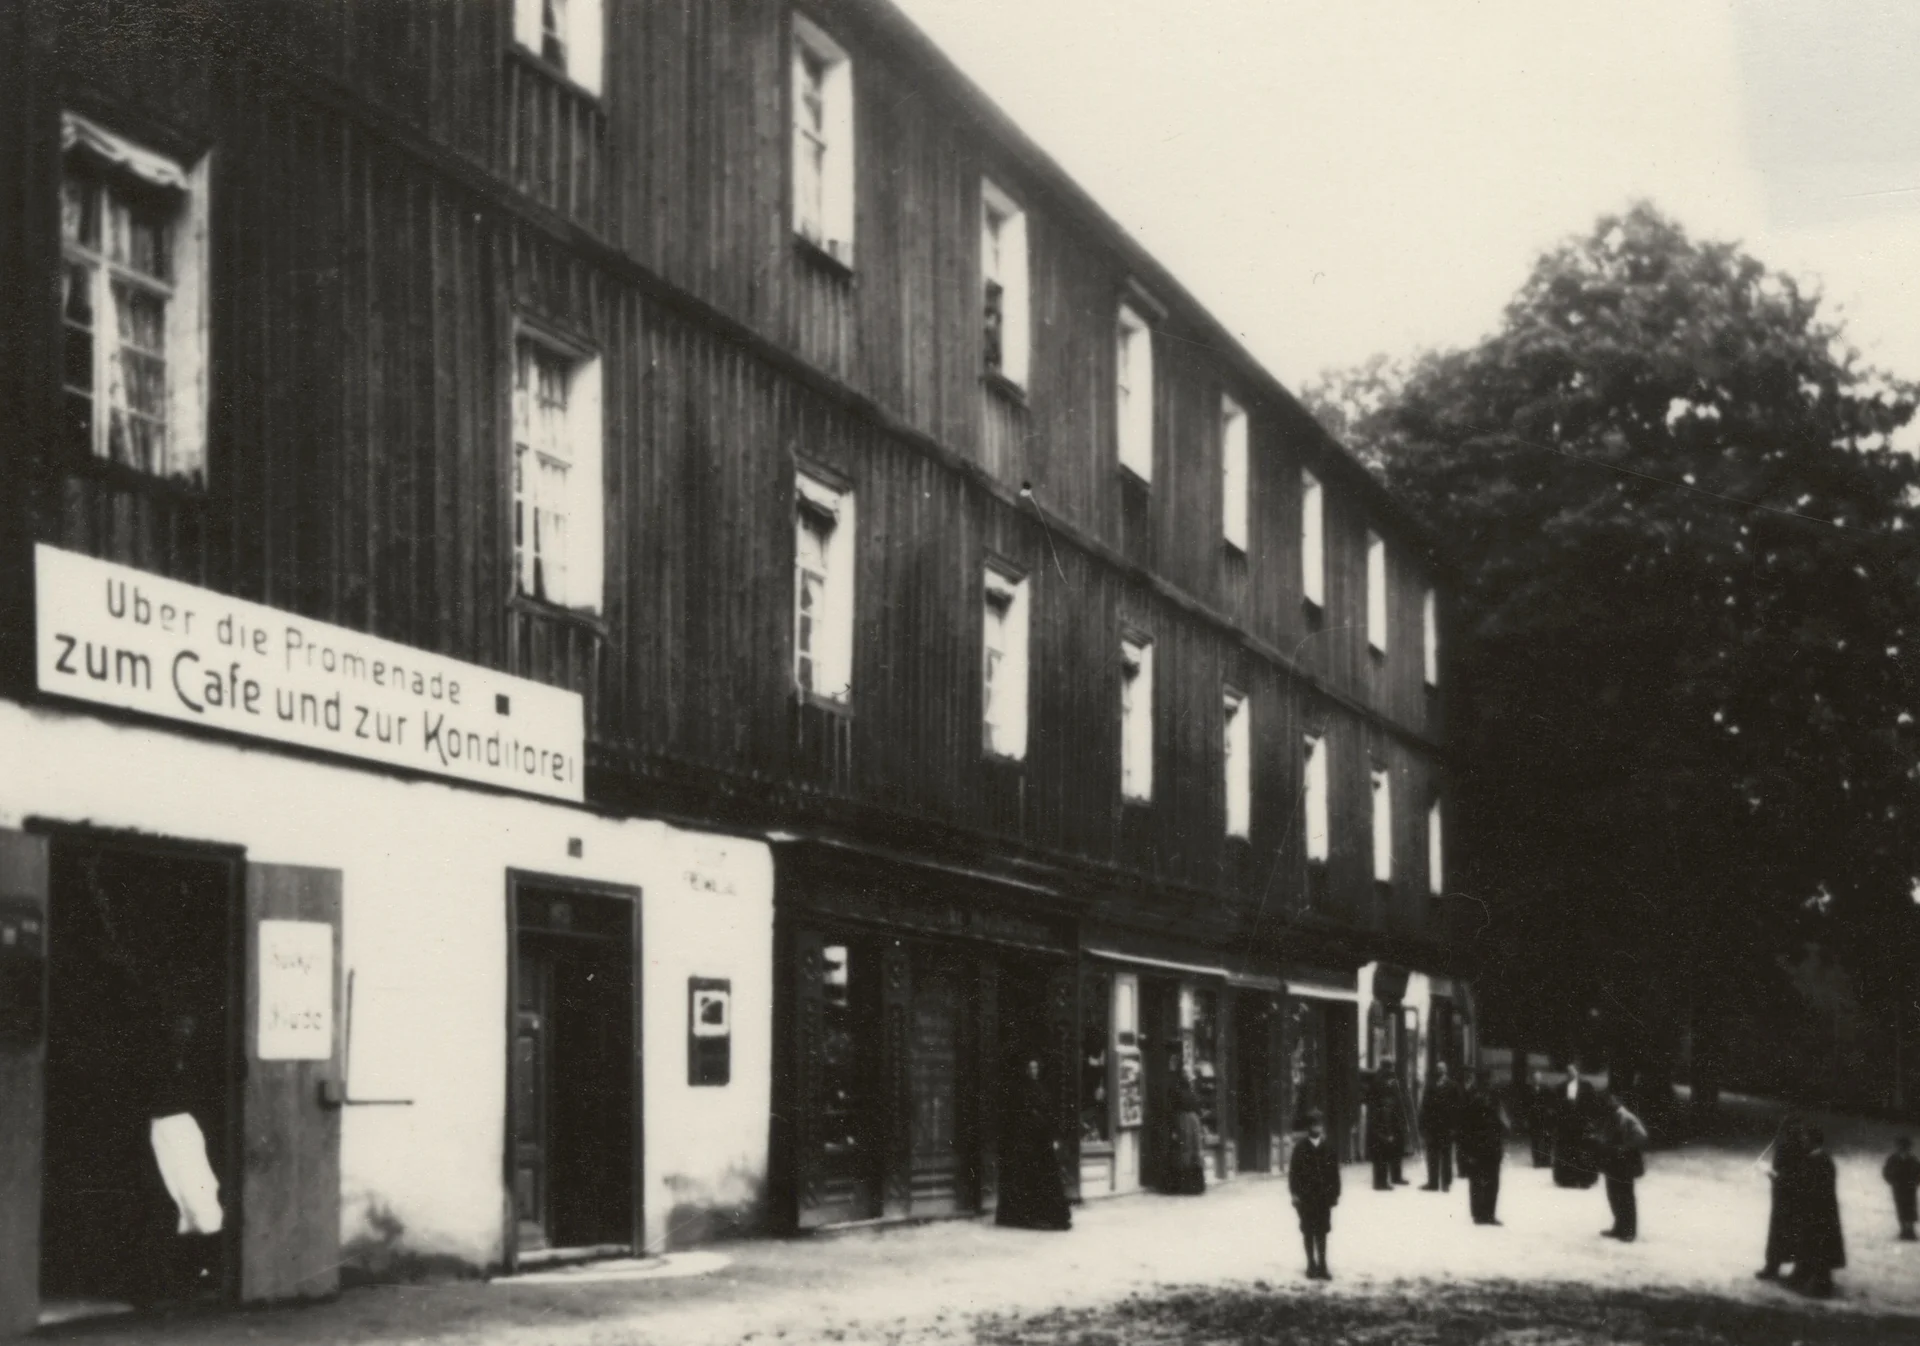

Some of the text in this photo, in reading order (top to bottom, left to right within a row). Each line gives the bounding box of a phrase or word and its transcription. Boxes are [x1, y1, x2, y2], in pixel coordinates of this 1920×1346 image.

[54, 632, 574, 784] zum Cafe und zur Konditorei
[217, 612, 268, 656] die
[285, 625, 461, 706] Promenade
